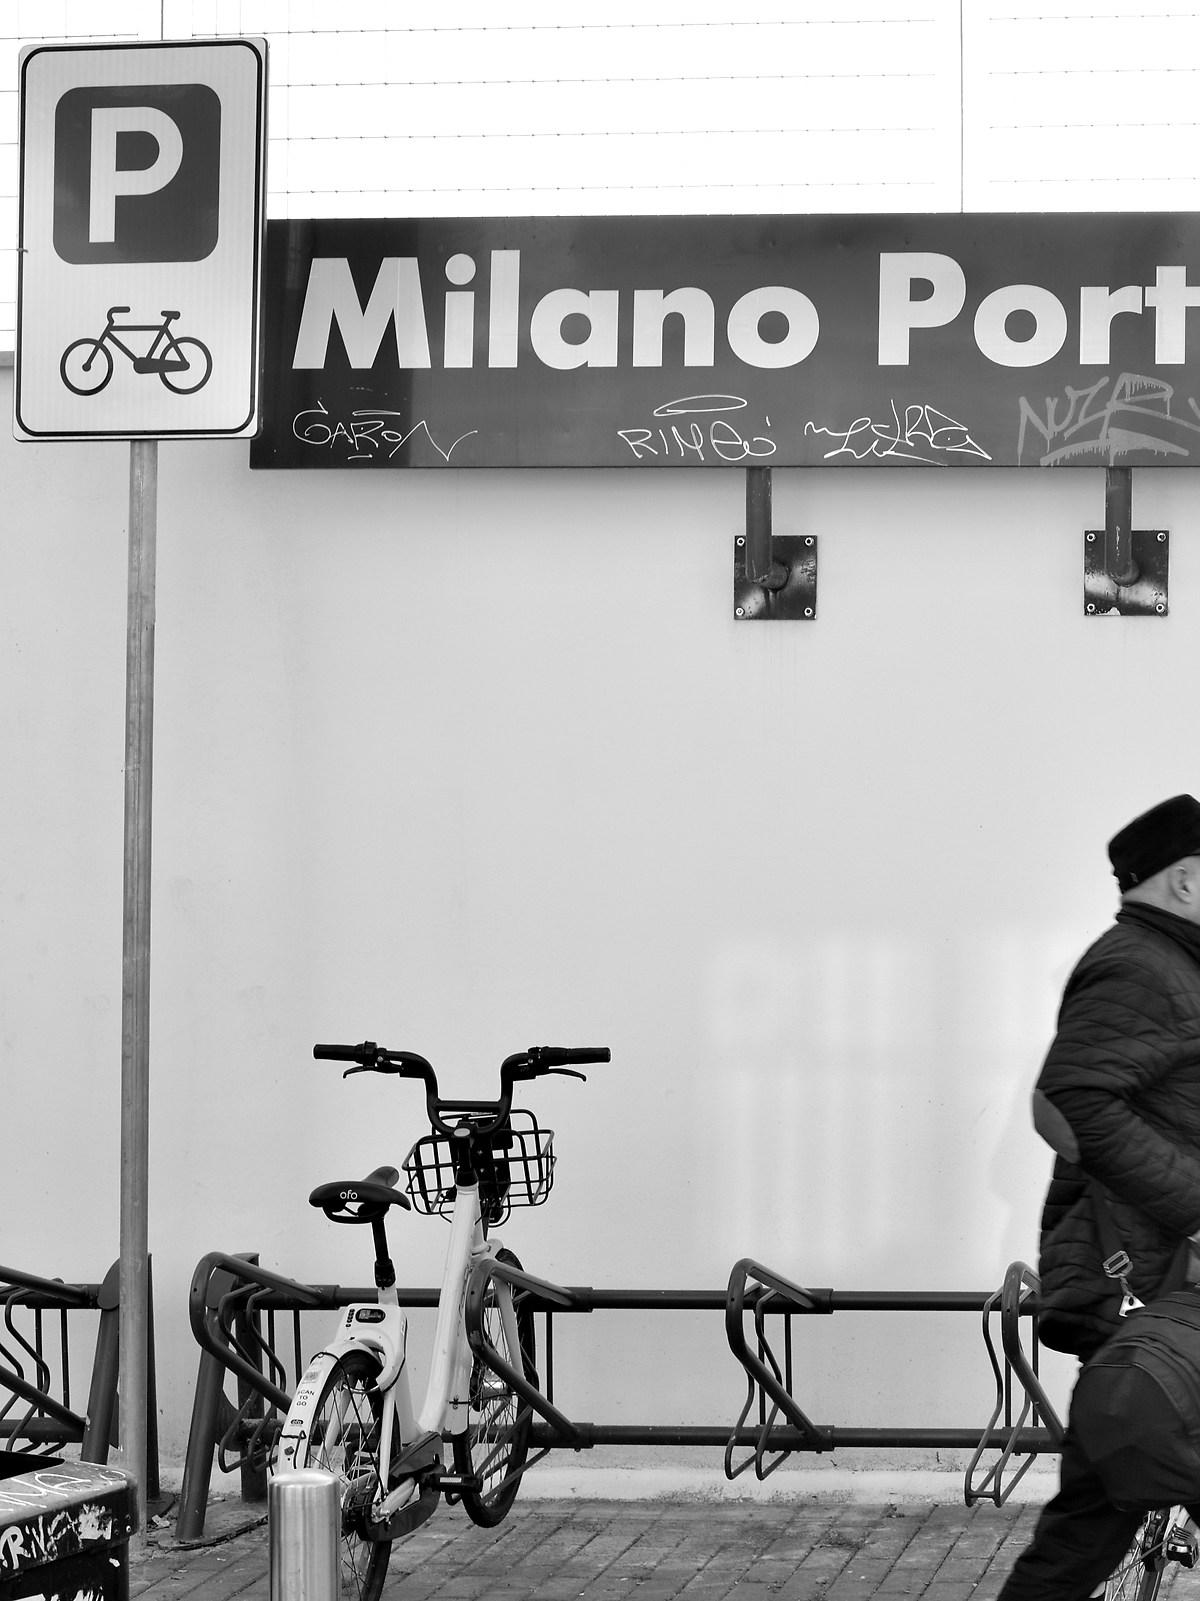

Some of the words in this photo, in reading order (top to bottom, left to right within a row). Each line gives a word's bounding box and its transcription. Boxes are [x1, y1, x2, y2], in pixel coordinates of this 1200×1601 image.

[89, 107, 183, 243] P
[292, 250, 820, 370] Milano
[340, 1189, 358, 1200] ofo
